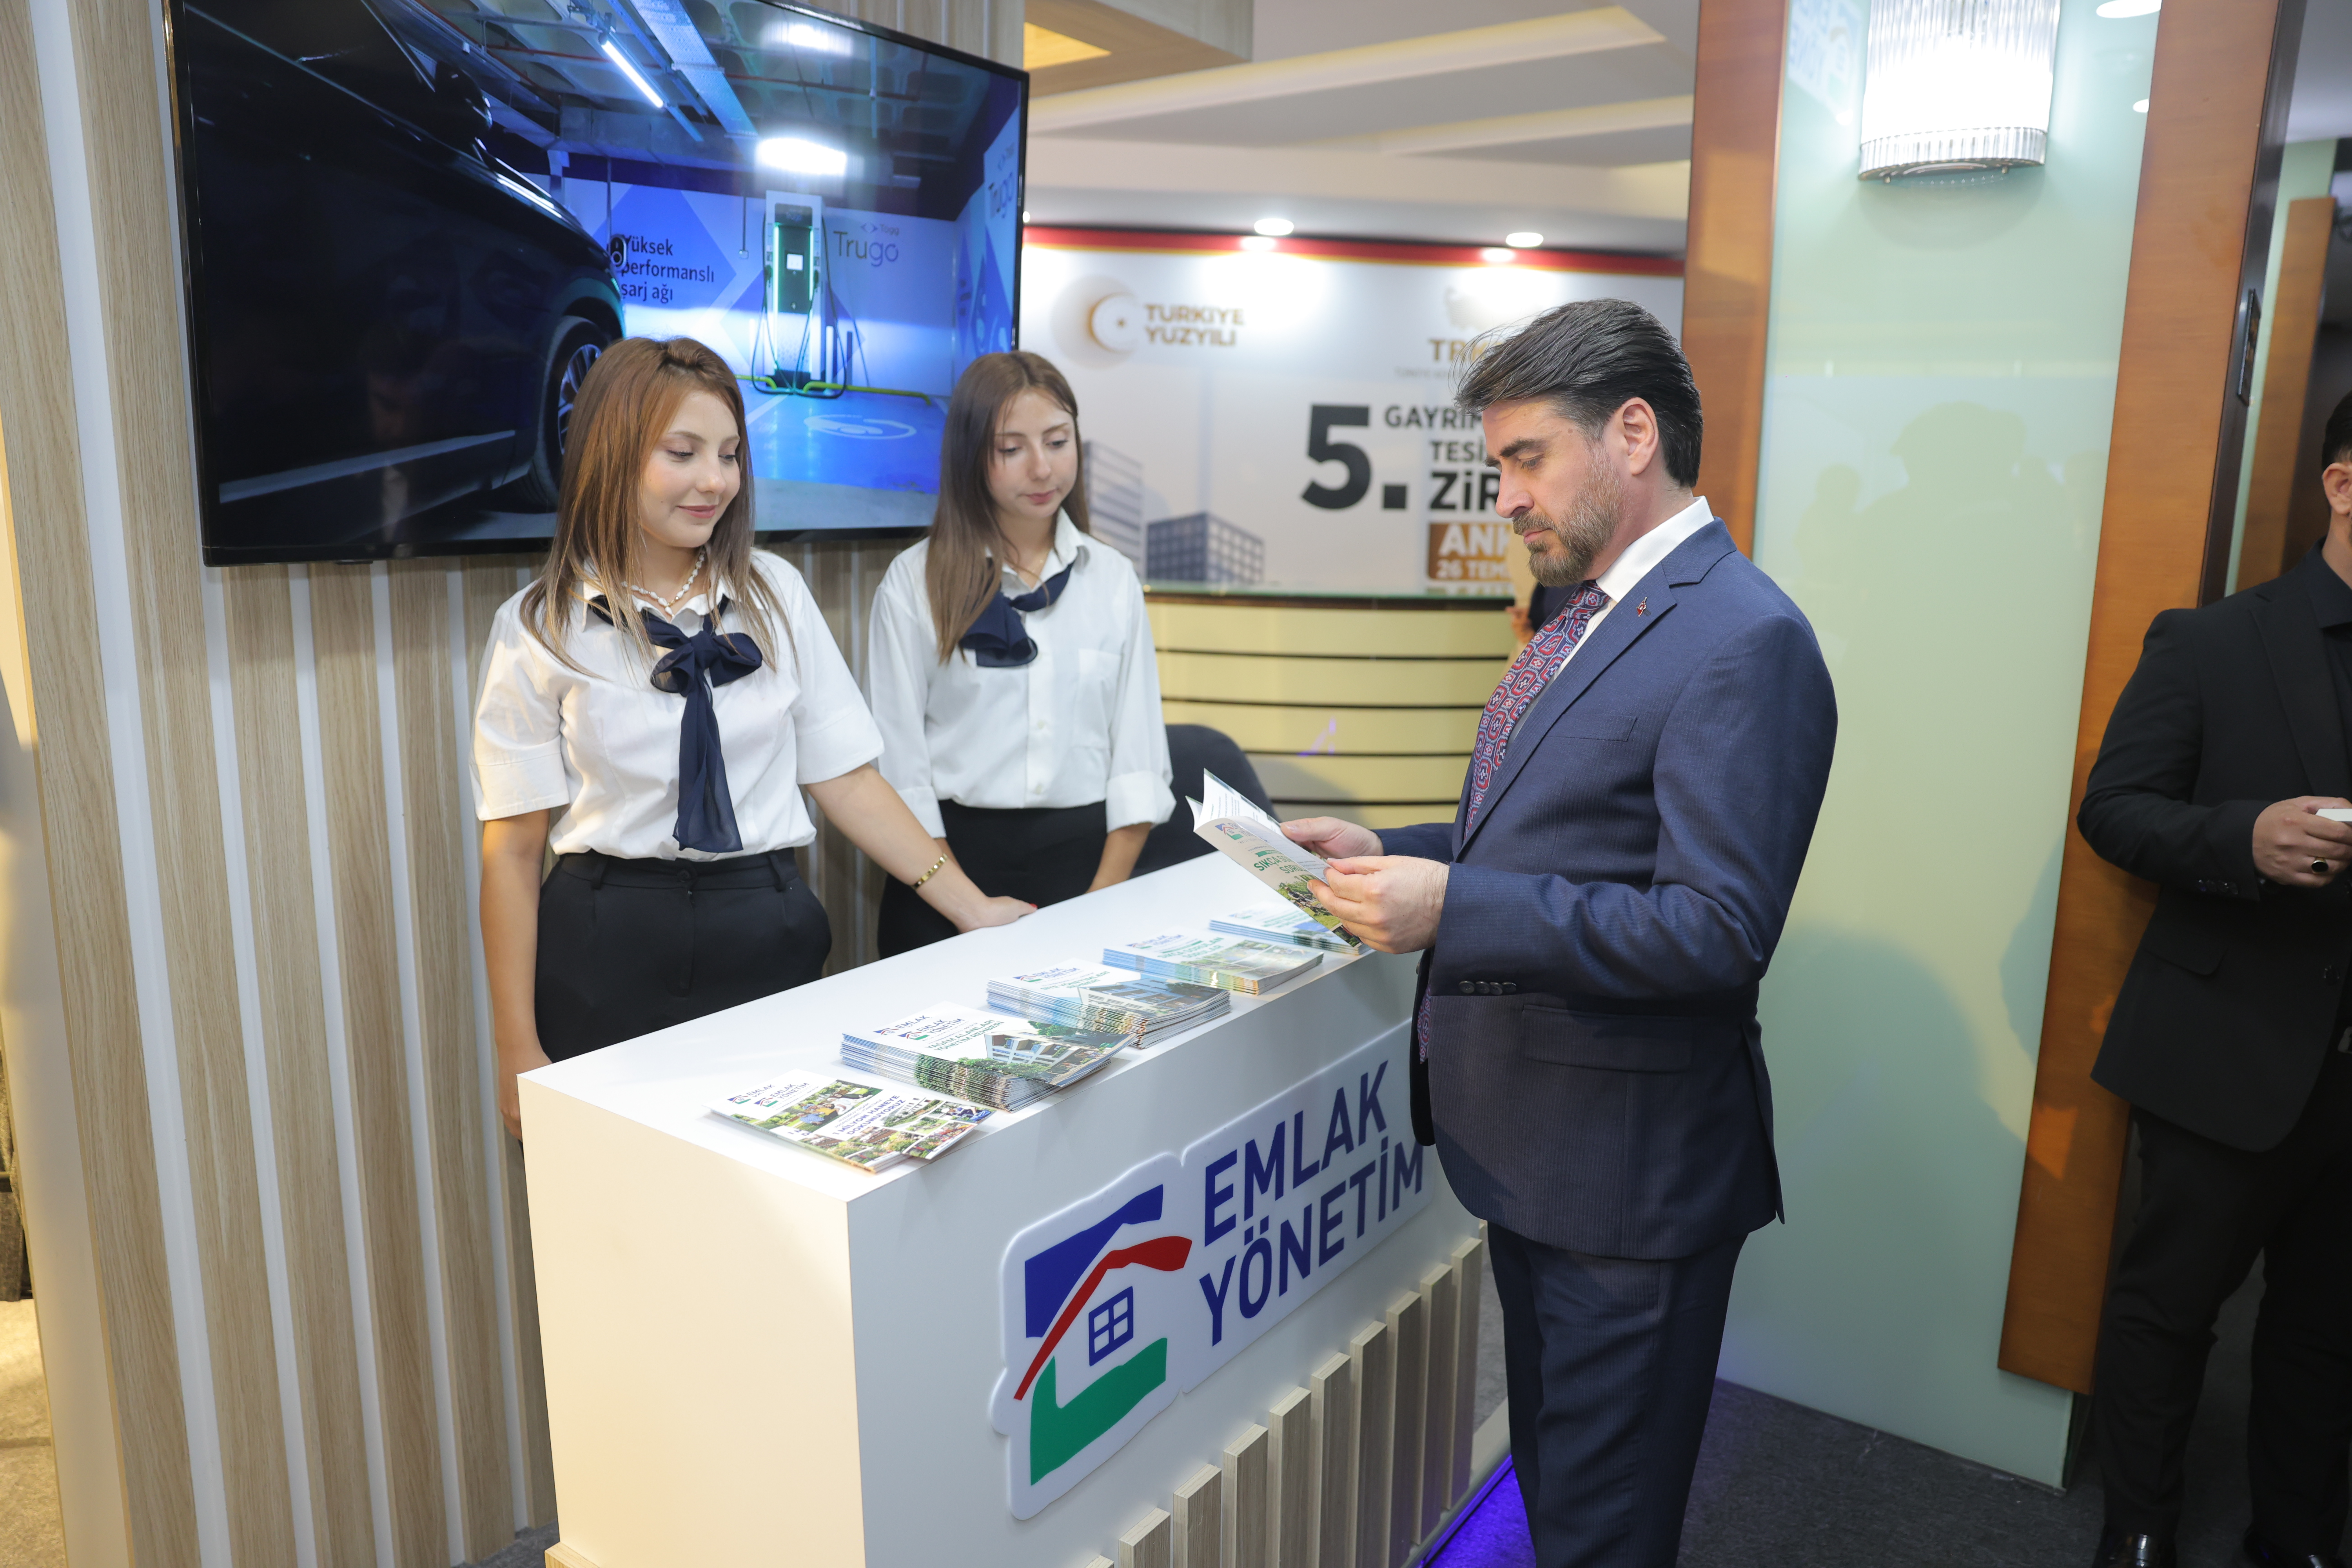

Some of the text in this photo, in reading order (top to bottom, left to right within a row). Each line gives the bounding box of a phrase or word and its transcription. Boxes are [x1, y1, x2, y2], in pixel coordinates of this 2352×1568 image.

[833, 230, 899, 267] Trugo
[621, 259, 714, 283] performanslı
[621, 281, 673, 304] şarj ağı
[1300, 405, 1407, 510] 5.
[1254, 856, 1283, 871] SIKÇA
[895, 1015, 930, 1029] EMLAK
[916, 1019, 948, 1032] EMLAK
[926, 1018, 965, 1034] YÖNETİM
[924, 1020, 996, 1049] YAŞAM ALANLARI
[932, 1021, 1005, 1051] YÖNETİM REHBERİ
[746, 1084, 776, 1096] EMLAK
[770, 1083, 796, 1098] EMLAK
[777, 1082, 809, 1099] YÖNETİM
[837, 1114, 870, 1132] MİLYON
[867, 1095, 900, 1114] HANEYE
[846, 1100, 906, 1135] DOKUNUYORUZ
[1205, 1060, 1388, 1247] EMLAK
[1199, 1136, 1423, 1347] YÖNETİM
